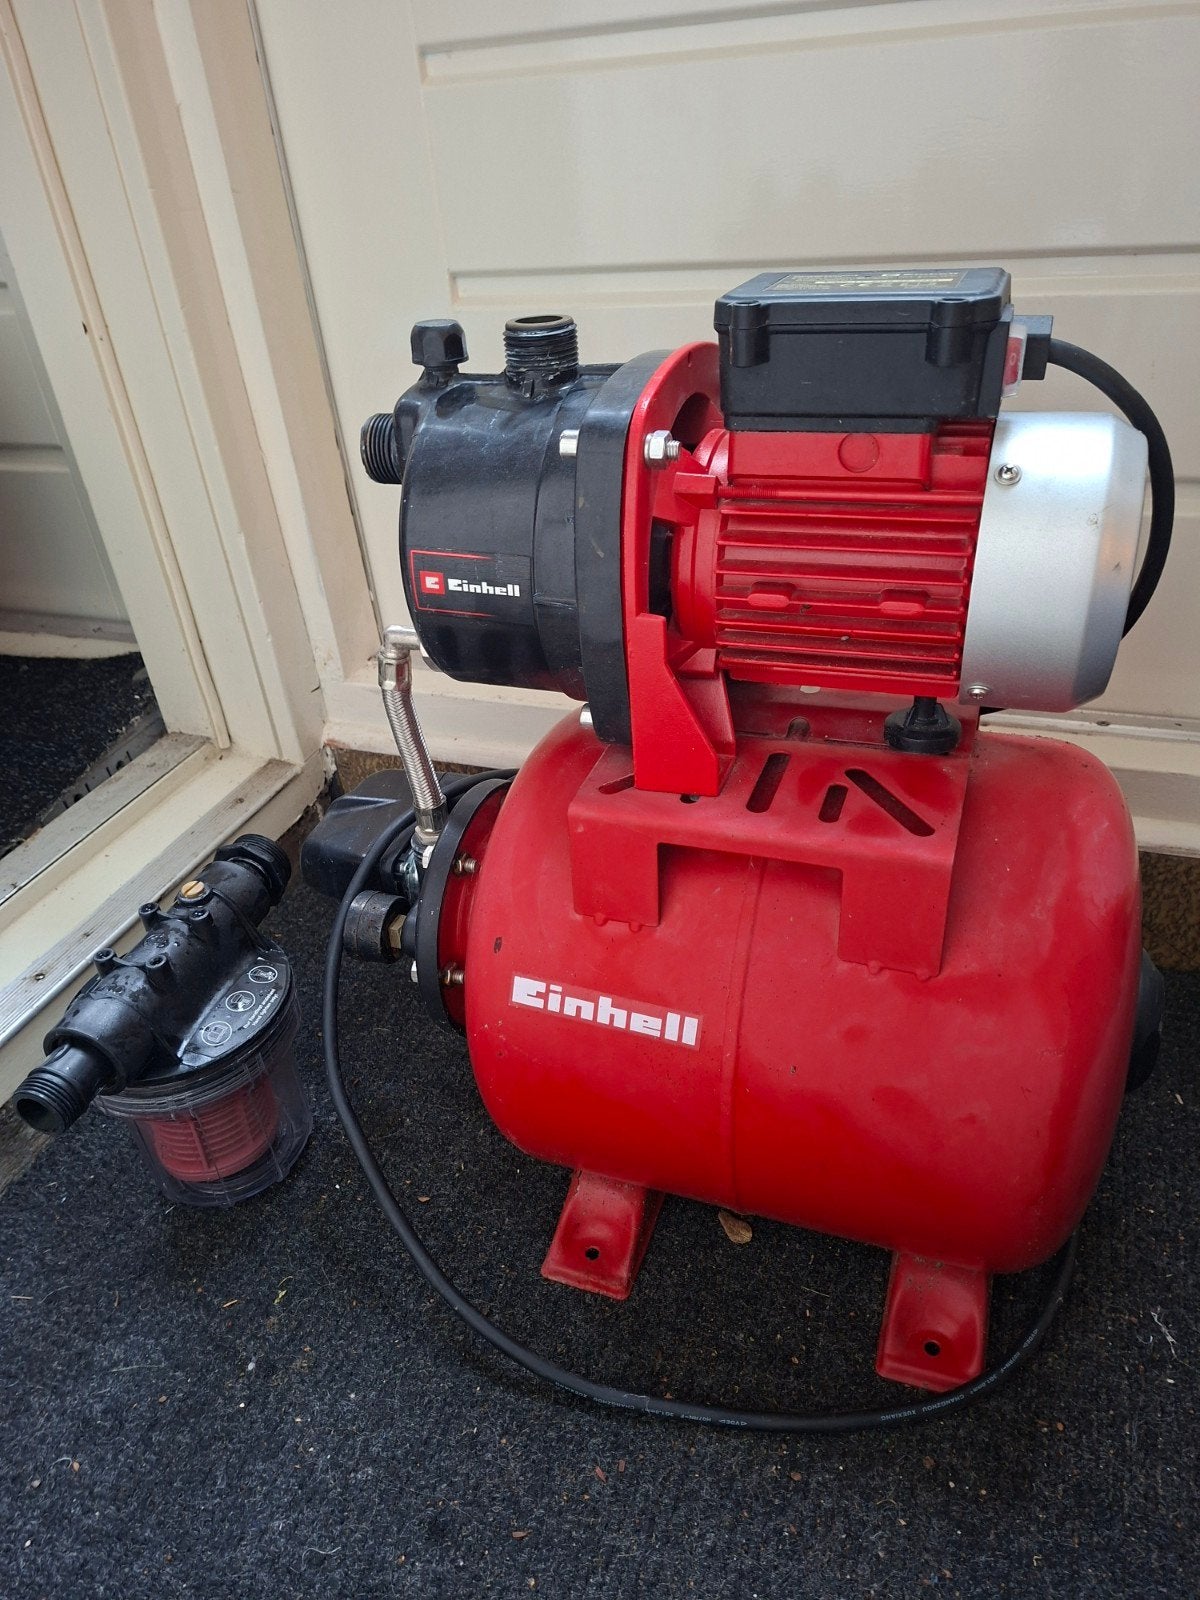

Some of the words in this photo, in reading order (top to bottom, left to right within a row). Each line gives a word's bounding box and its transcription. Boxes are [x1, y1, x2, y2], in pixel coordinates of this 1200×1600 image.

[447, 578, 520, 597] Einhell
[512, 975, 699, 1046] Einhell
[922, 1394, 965, 1412] CHANGZHOU
